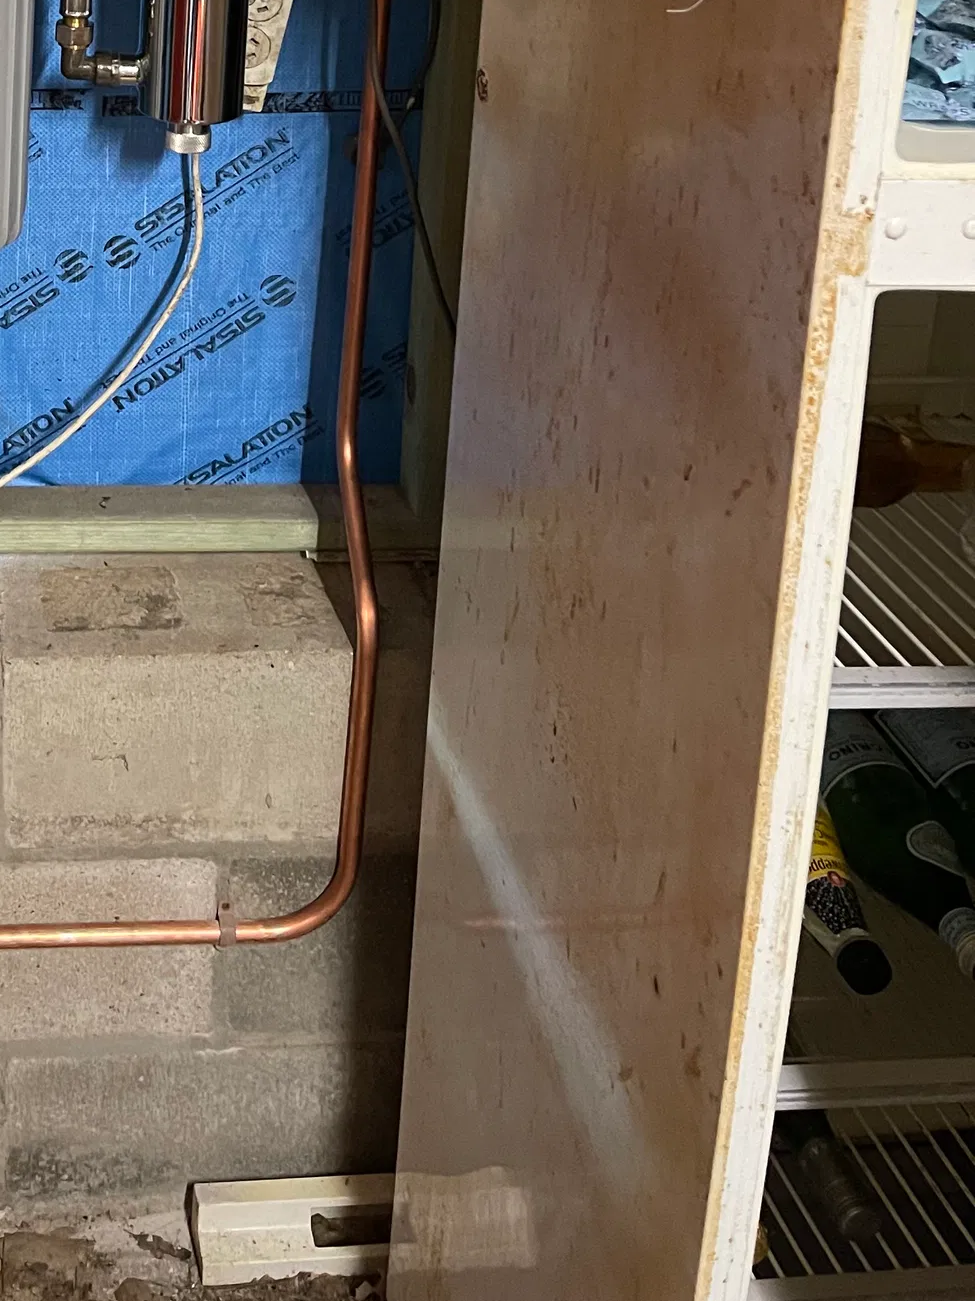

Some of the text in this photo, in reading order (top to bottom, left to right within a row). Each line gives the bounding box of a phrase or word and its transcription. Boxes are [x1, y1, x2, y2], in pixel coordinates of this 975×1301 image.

[149, 233, 175, 252] The
[224, 186, 247, 206] and
[247, 172, 271, 190] The
[273, 152, 300, 174] Best
[21, 267, 44, 285] The
[227, 292, 250, 309] The
[179, 307, 227, 341] Original
[155, 337, 177, 356] and
[112, 305, 266, 413] SISALATION
[249, 457, 272, 474] and
